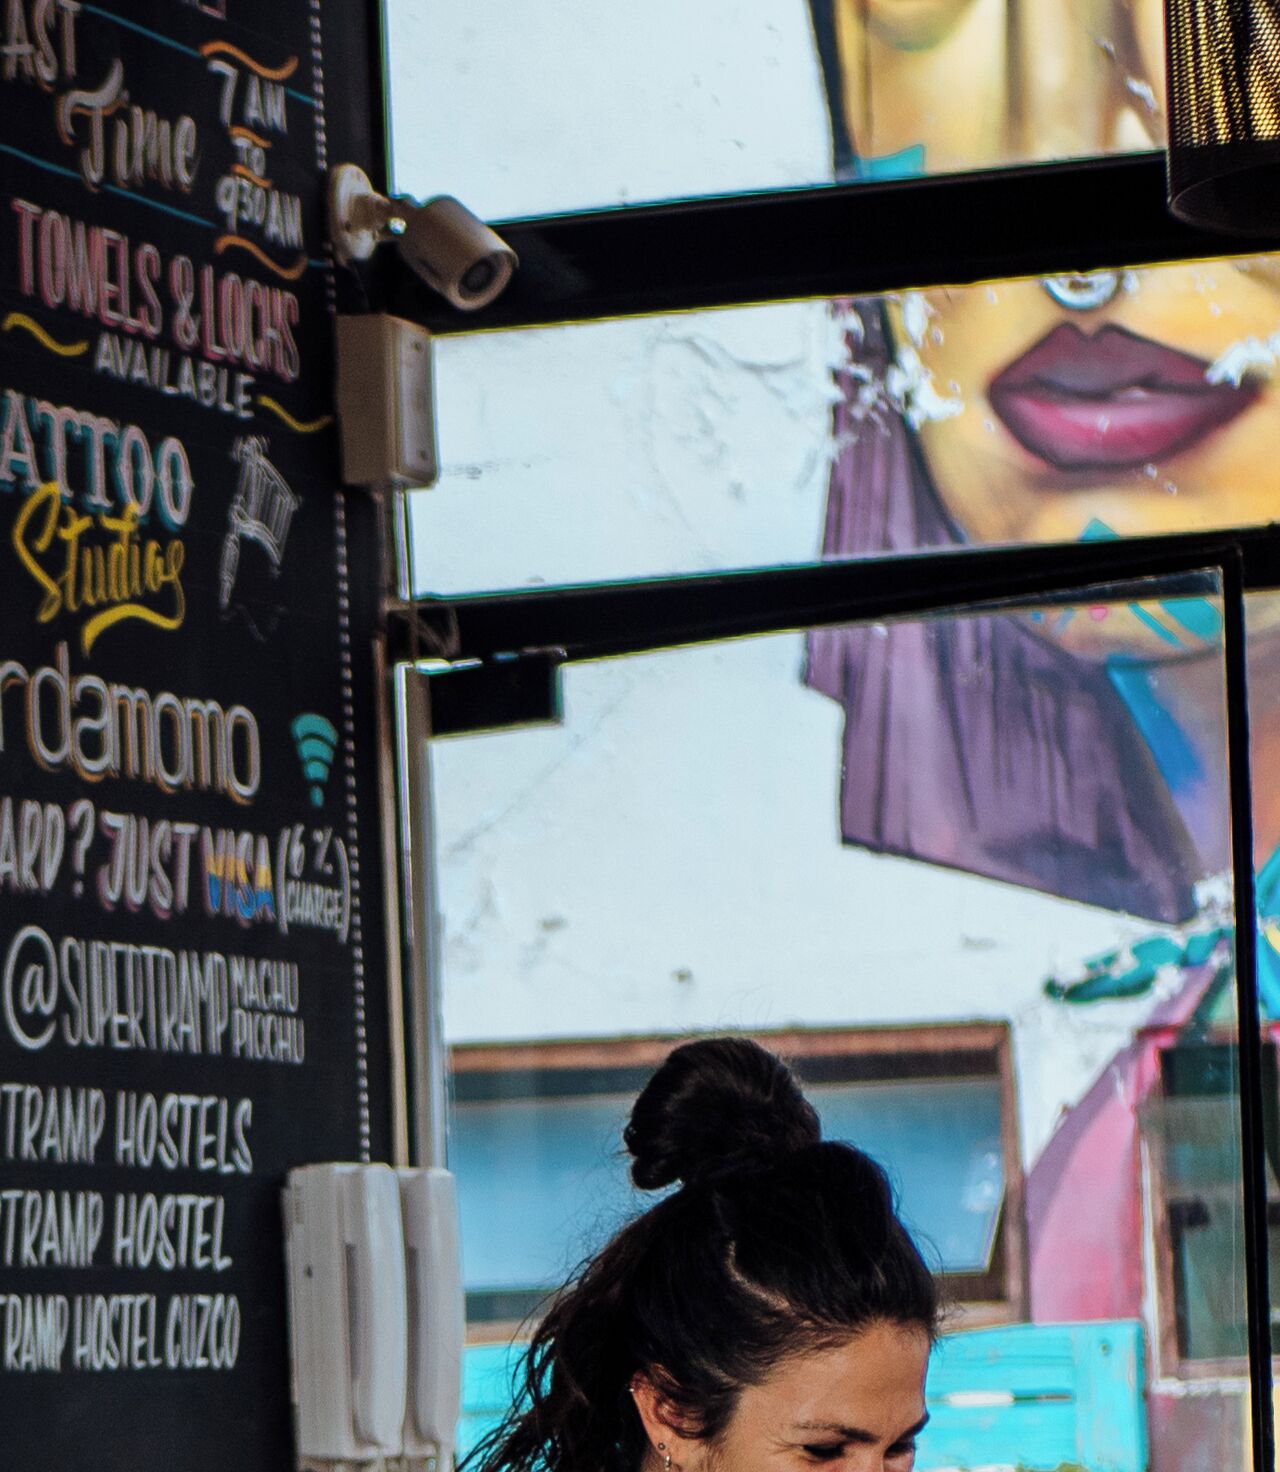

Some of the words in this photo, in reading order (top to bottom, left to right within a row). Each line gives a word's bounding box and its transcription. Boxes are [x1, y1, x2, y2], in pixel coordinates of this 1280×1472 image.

[57, 58, 199, 193] Time
[207, 59, 238, 128] 7
[11, 199, 161, 339] TOWELS
[200, 264, 300, 384] LOCKS
[94, 332, 257, 420] AVAILABLE
[12, 481, 186, 661] Studios
[97, 811, 200, 919] JUST
[201, 825, 275, 928] VISA
[231, 958, 299, 1013] MACHU
[232, 1011, 306, 1065] PICCHU
[115, 1090, 253, 1175] HOSTELS
[114, 1190, 232, 1270] HOSTEL
[73, 1293, 163, 1370] HOSTEL
[165, 1294, 241, 1370] CUZCO
